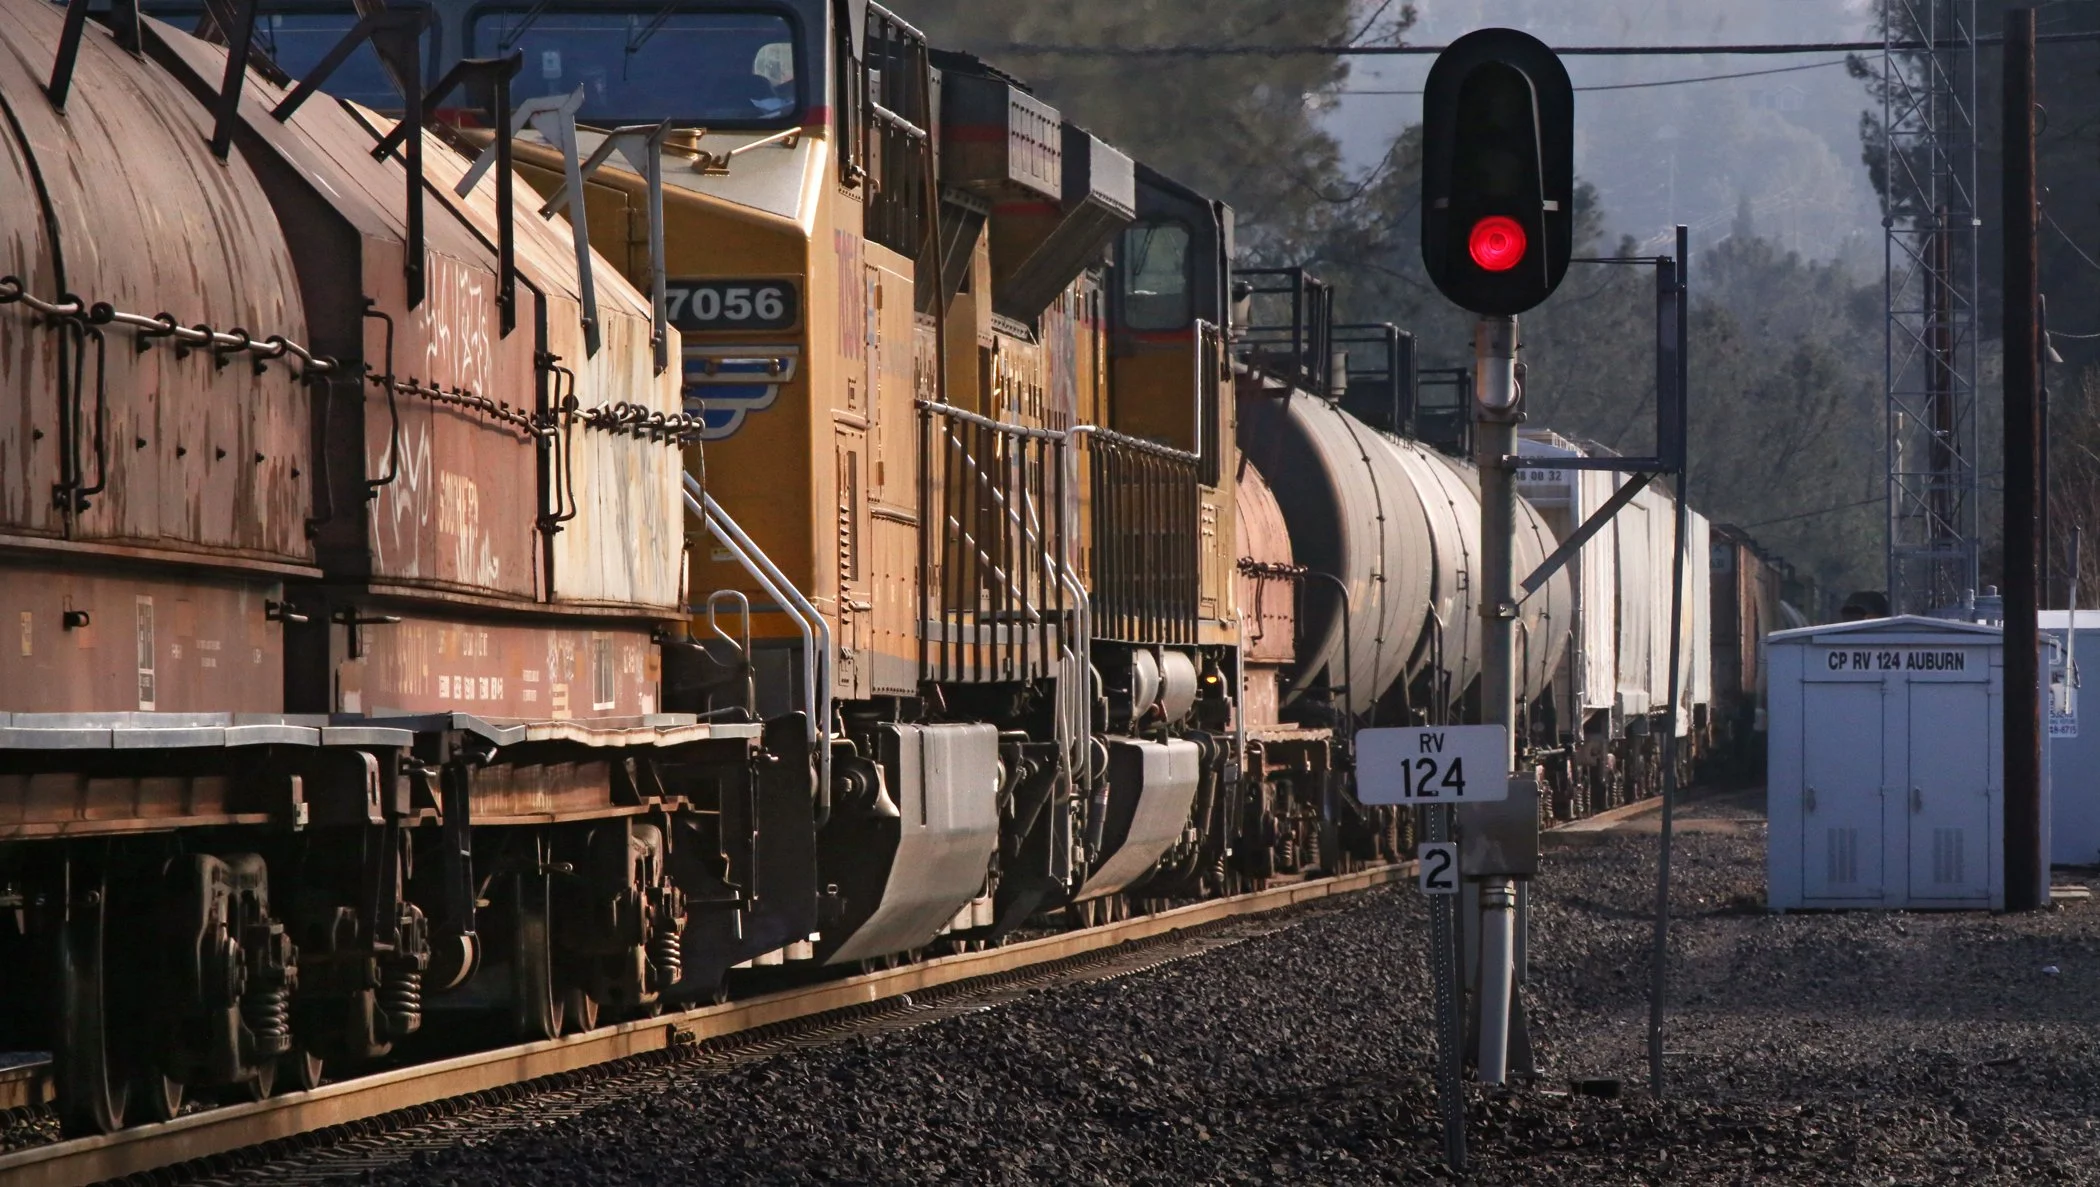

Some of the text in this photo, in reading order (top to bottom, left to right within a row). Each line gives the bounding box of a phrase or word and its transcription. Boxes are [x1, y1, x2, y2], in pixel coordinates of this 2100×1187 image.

[665, 287, 784, 320] 7056
[1548, 470, 1562, 481] 32
[1828, 651, 1965, 671] CP RV 124 AUBURN
[1420, 733, 1444, 753] RV
[1401, 757, 1466, 797] 124
[1425, 848, 1452, 889] 2
